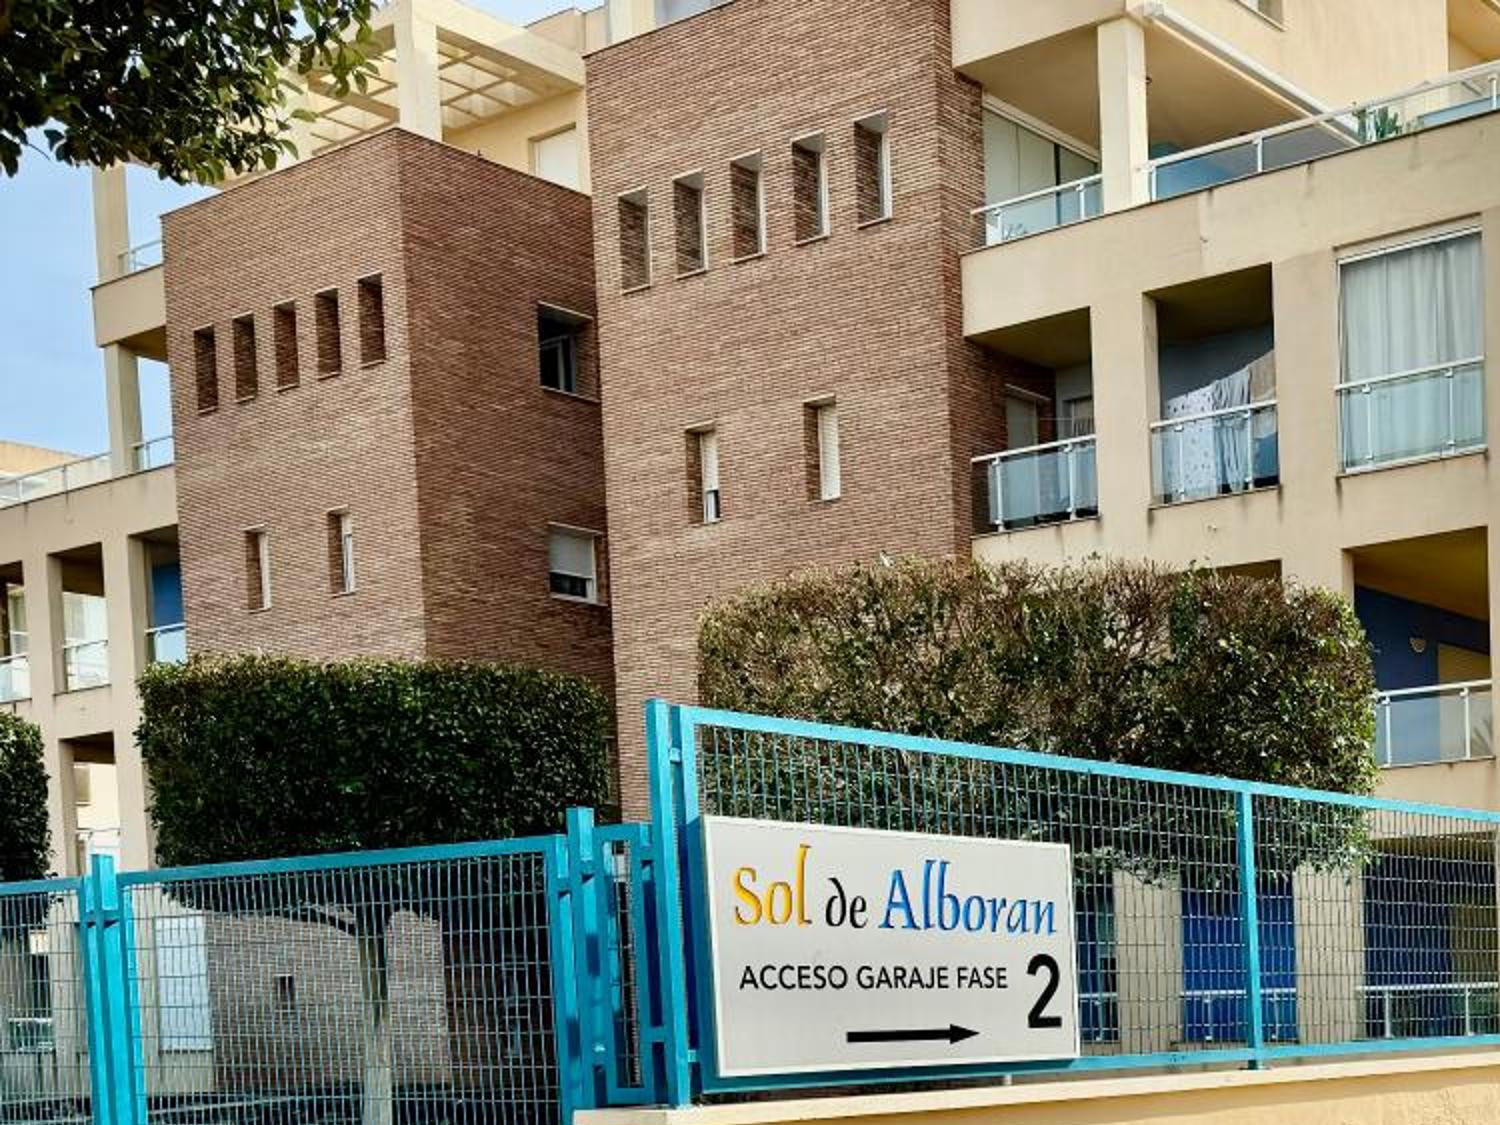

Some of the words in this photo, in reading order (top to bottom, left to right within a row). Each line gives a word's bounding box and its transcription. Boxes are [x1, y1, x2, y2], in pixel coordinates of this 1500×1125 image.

[732, 843, 812, 928] Sol
[825, 877, 867, 929] de
[878, 859, 1057, 936] Alboran
[739, 964, 848, 990] ACCESO
[857, 965, 949, 990] GARAJE
[958, 966, 1008, 990] FASE
[1026, 953, 1062, 1029] 2
